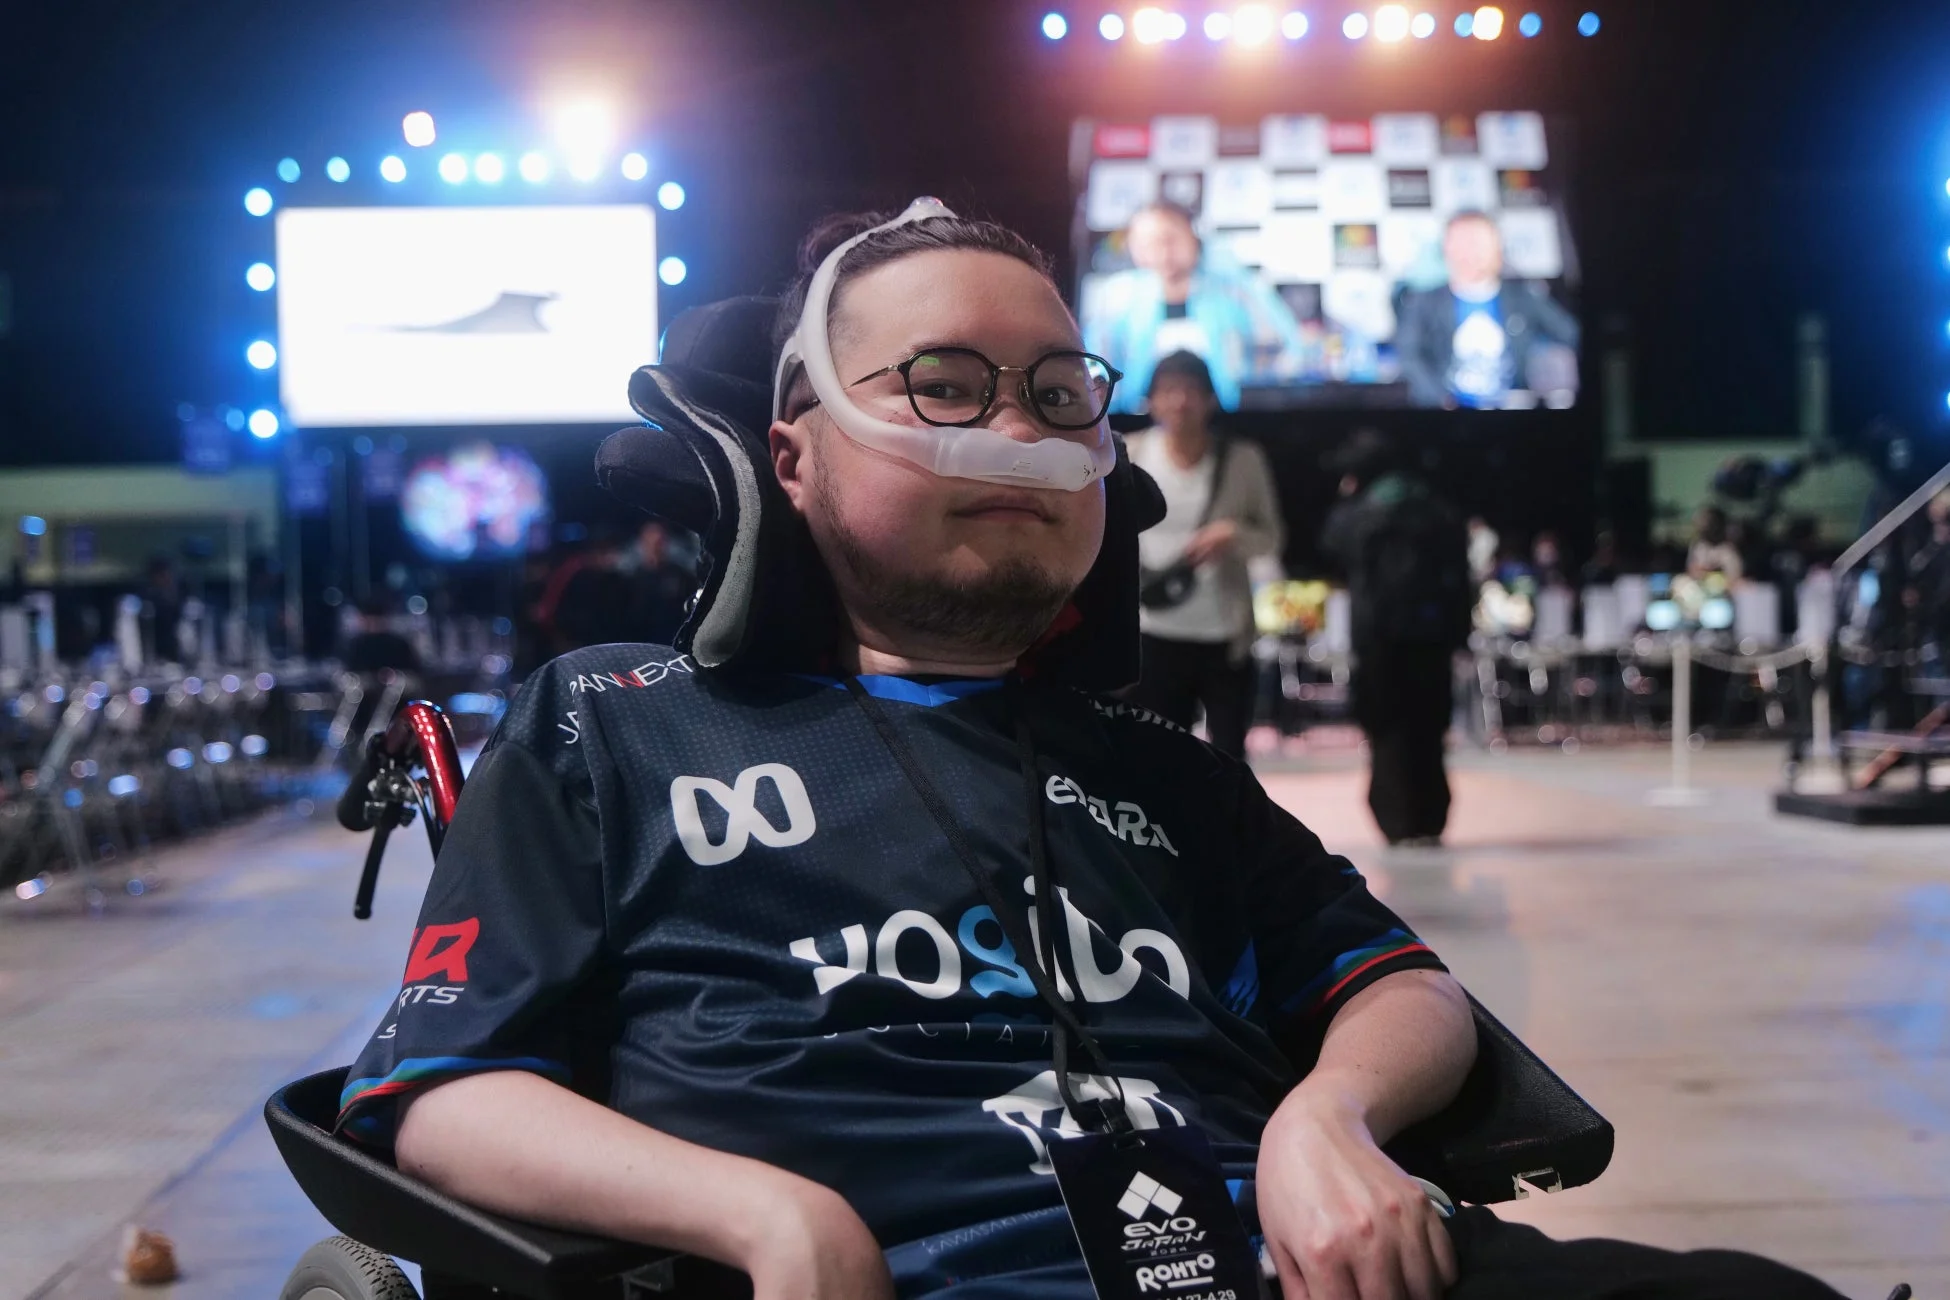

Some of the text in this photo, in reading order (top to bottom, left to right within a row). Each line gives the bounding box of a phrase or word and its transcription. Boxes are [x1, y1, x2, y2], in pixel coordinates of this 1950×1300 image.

[1123, 1216, 1197, 1238] EVO
[1120, 1230, 1207, 1251] JAPAN
[1135, 1253, 1216, 1293] ROHTO
